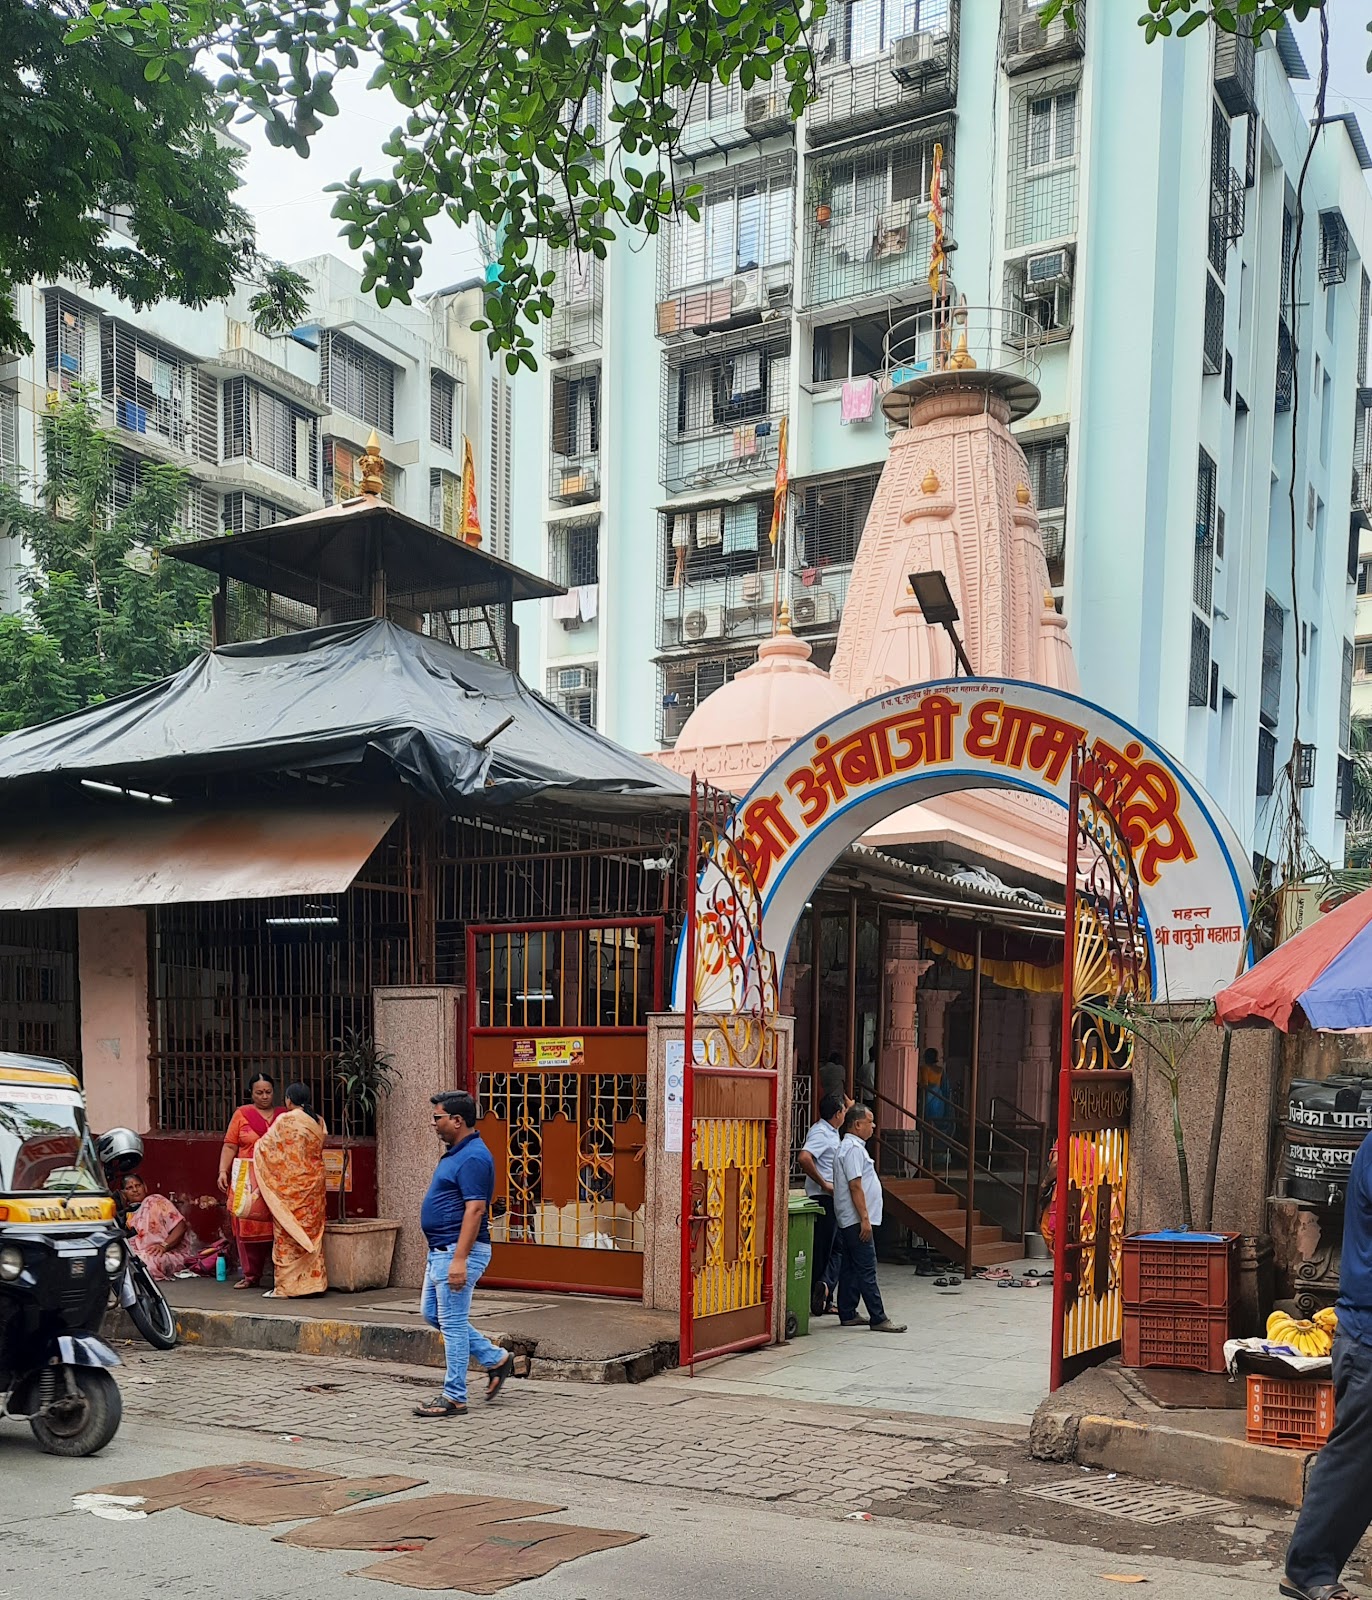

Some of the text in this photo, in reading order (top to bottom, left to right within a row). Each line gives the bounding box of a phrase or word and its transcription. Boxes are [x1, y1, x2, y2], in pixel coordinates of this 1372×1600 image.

[922, 687, 932, 697] श्री
[960, 686, 980, 694] महाराज
[981, 684, 989, 692] की
[726, 791, 800, 892] श्री
[784, 695, 961, 829] अंबाजी
[962, 698, 1089, 787] धाम
[1171, 907, 1212, 921] महन्त
[1155, 925, 1170, 945] श्री
[1206, 925, 1242, 945] महाराज
